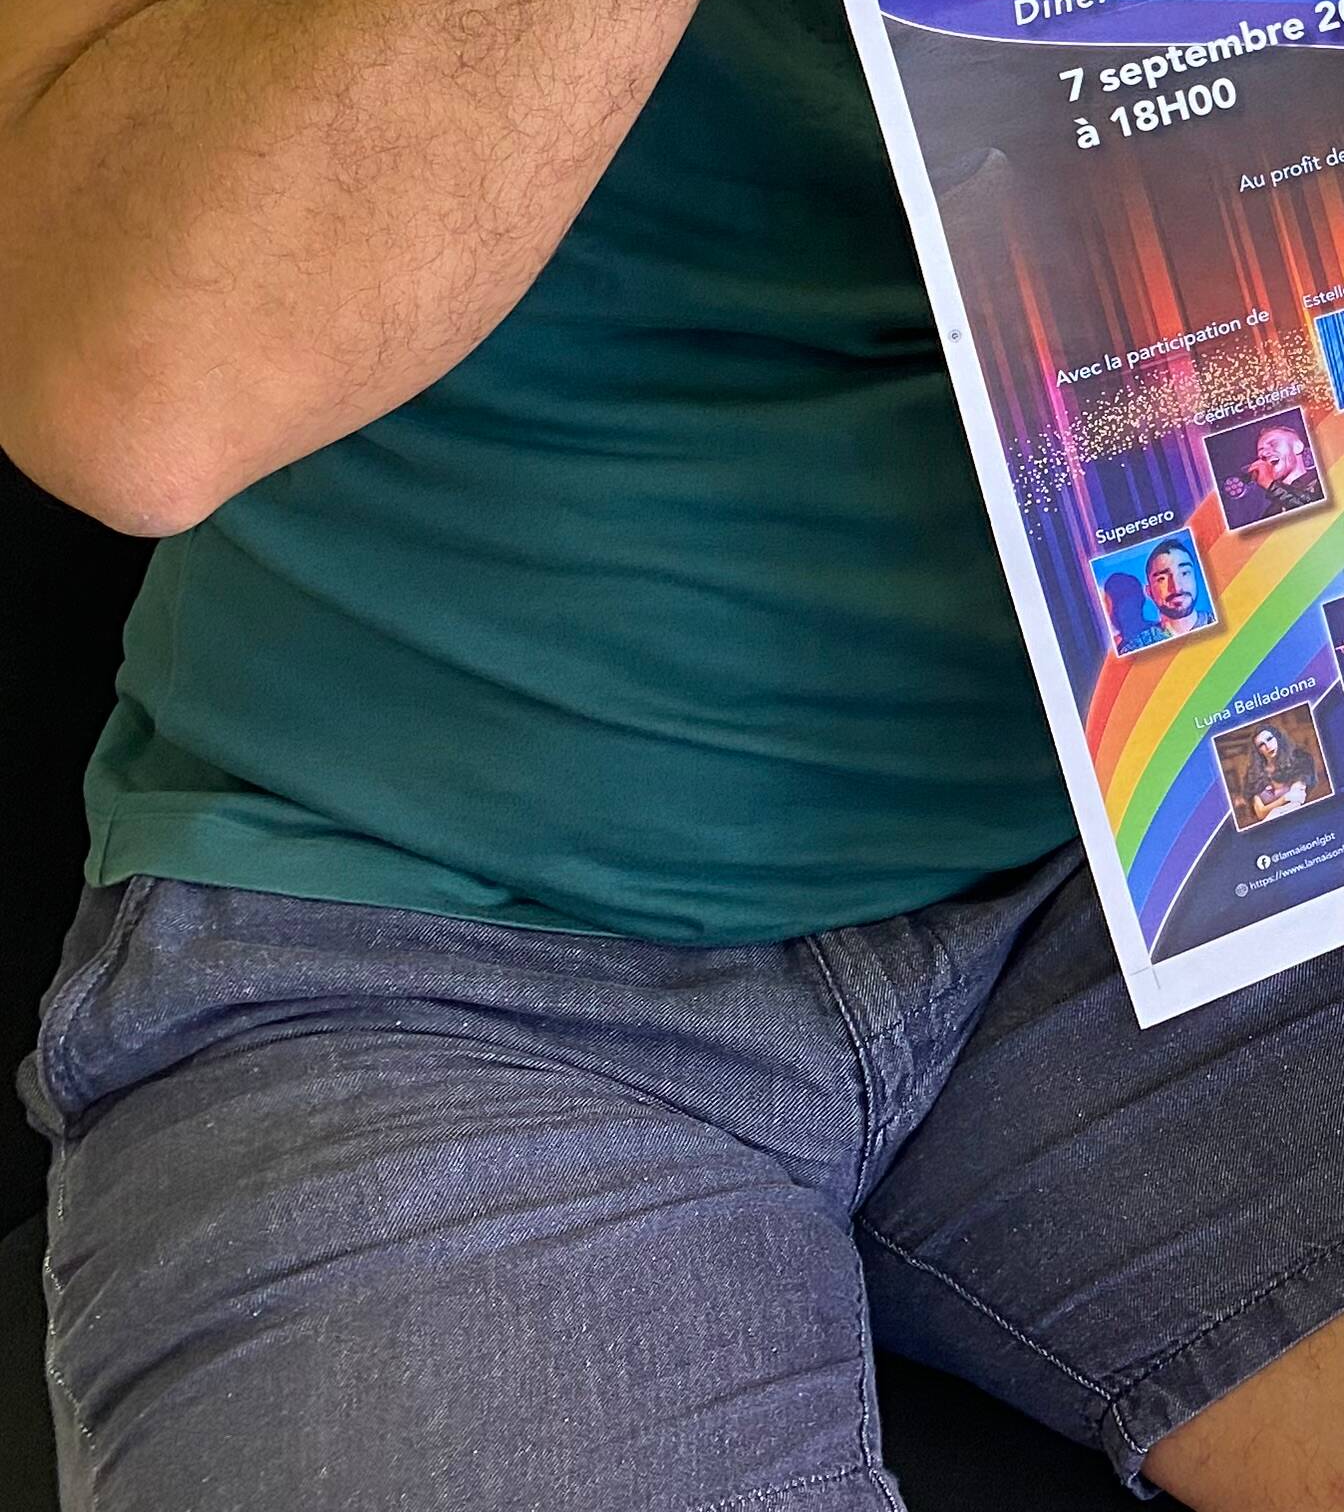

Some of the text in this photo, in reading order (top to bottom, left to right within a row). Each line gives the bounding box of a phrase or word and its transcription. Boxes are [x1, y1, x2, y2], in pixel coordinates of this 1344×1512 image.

[1059, 67, 1084, 103] 7
[1099, 17, 1306, 93] septembre
[1073, 76, 1238, 150] à 18H00
[1239, 170, 1265, 193] Au
[1270, 154, 1322, 187] profit
[1056, 309, 1270, 387] Avec la participation de
[1095, 508, 1175, 544] Supersero
[1194, 676, 1317, 729] Luna Belladonna
